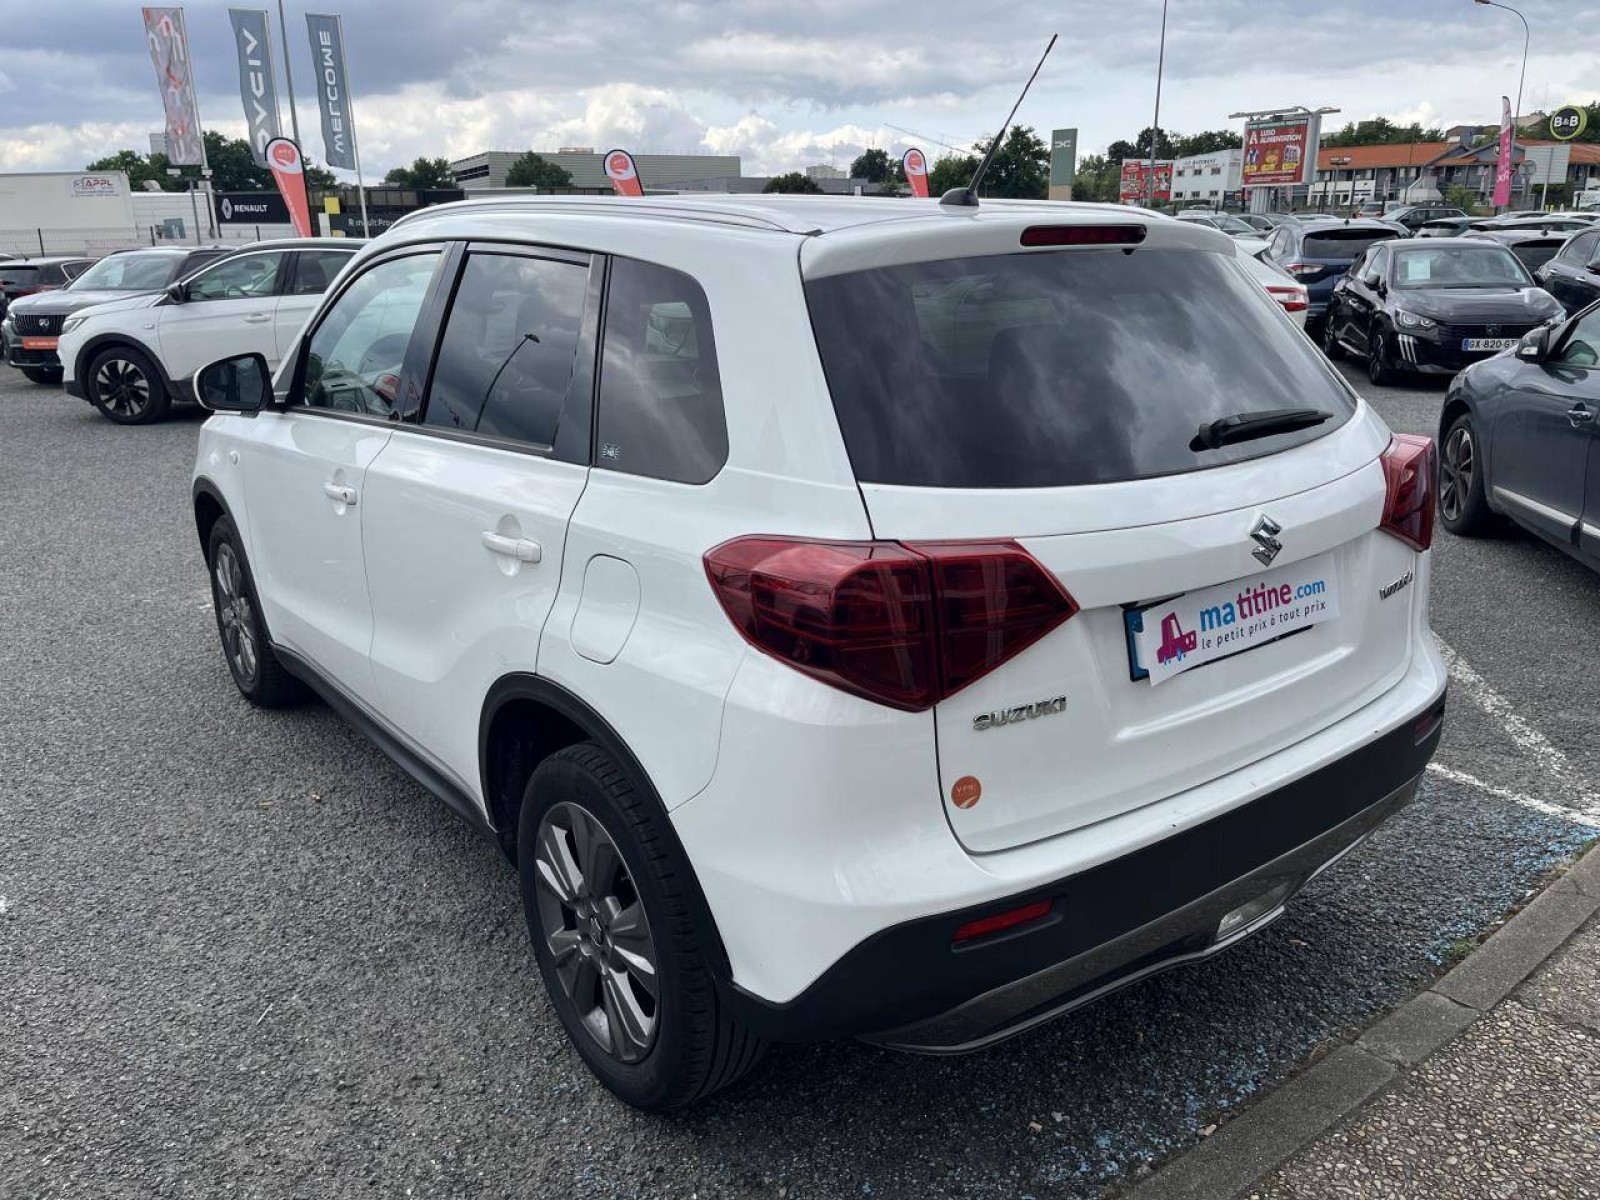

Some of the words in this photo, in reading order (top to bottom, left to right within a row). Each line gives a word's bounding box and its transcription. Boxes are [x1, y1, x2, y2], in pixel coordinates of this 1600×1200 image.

[1554, 115, 1579, 127] B&B
[233, 204, 268, 213] RENAULT
[1202, 637, 1213, 650] le
[1216, 627, 1245, 651] petit
[1249, 618, 1268, 638] prix
[1270, 613, 1277, 626] à
[1279, 609, 1301, 624] tout
[1304, 600, 1327, 619] prix
[973, 695, 1067, 731] SUZUKI
